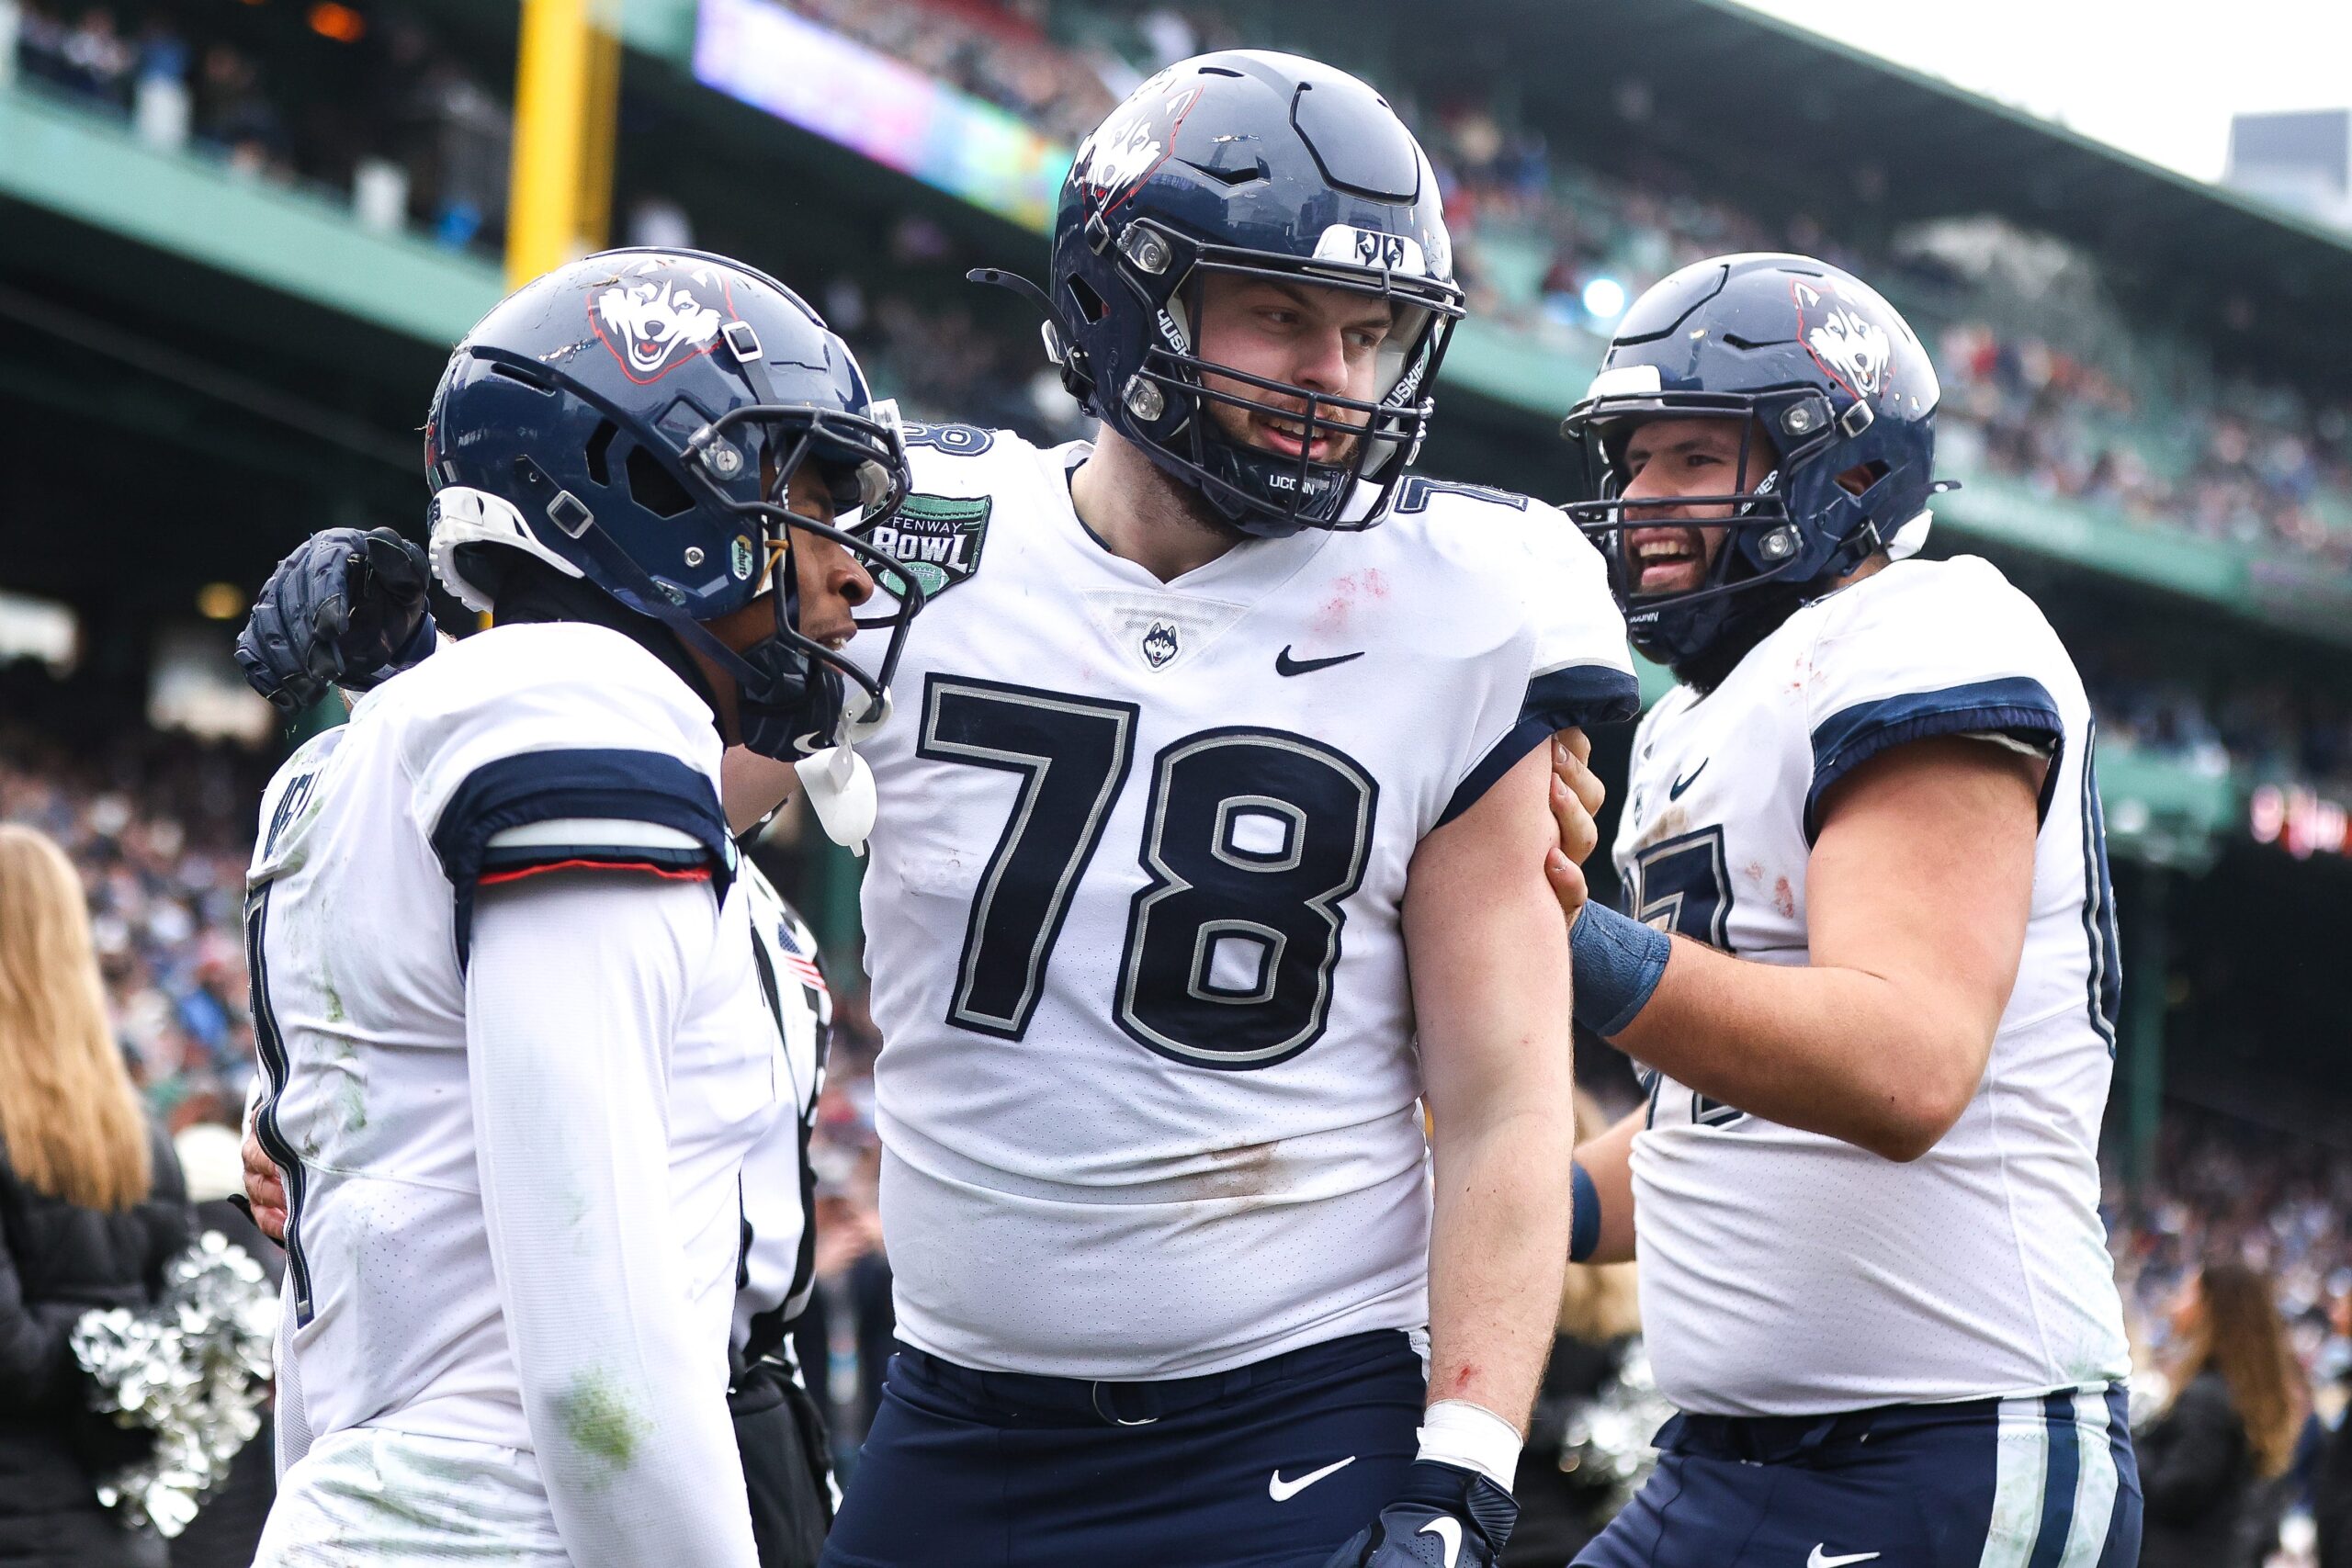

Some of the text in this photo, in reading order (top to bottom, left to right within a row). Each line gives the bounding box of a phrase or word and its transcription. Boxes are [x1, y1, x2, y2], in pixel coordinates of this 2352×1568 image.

[892, 516, 962, 534] FENWAY
[872, 526, 968, 574] BOWL
[916, 672, 1380, 1071] 78
